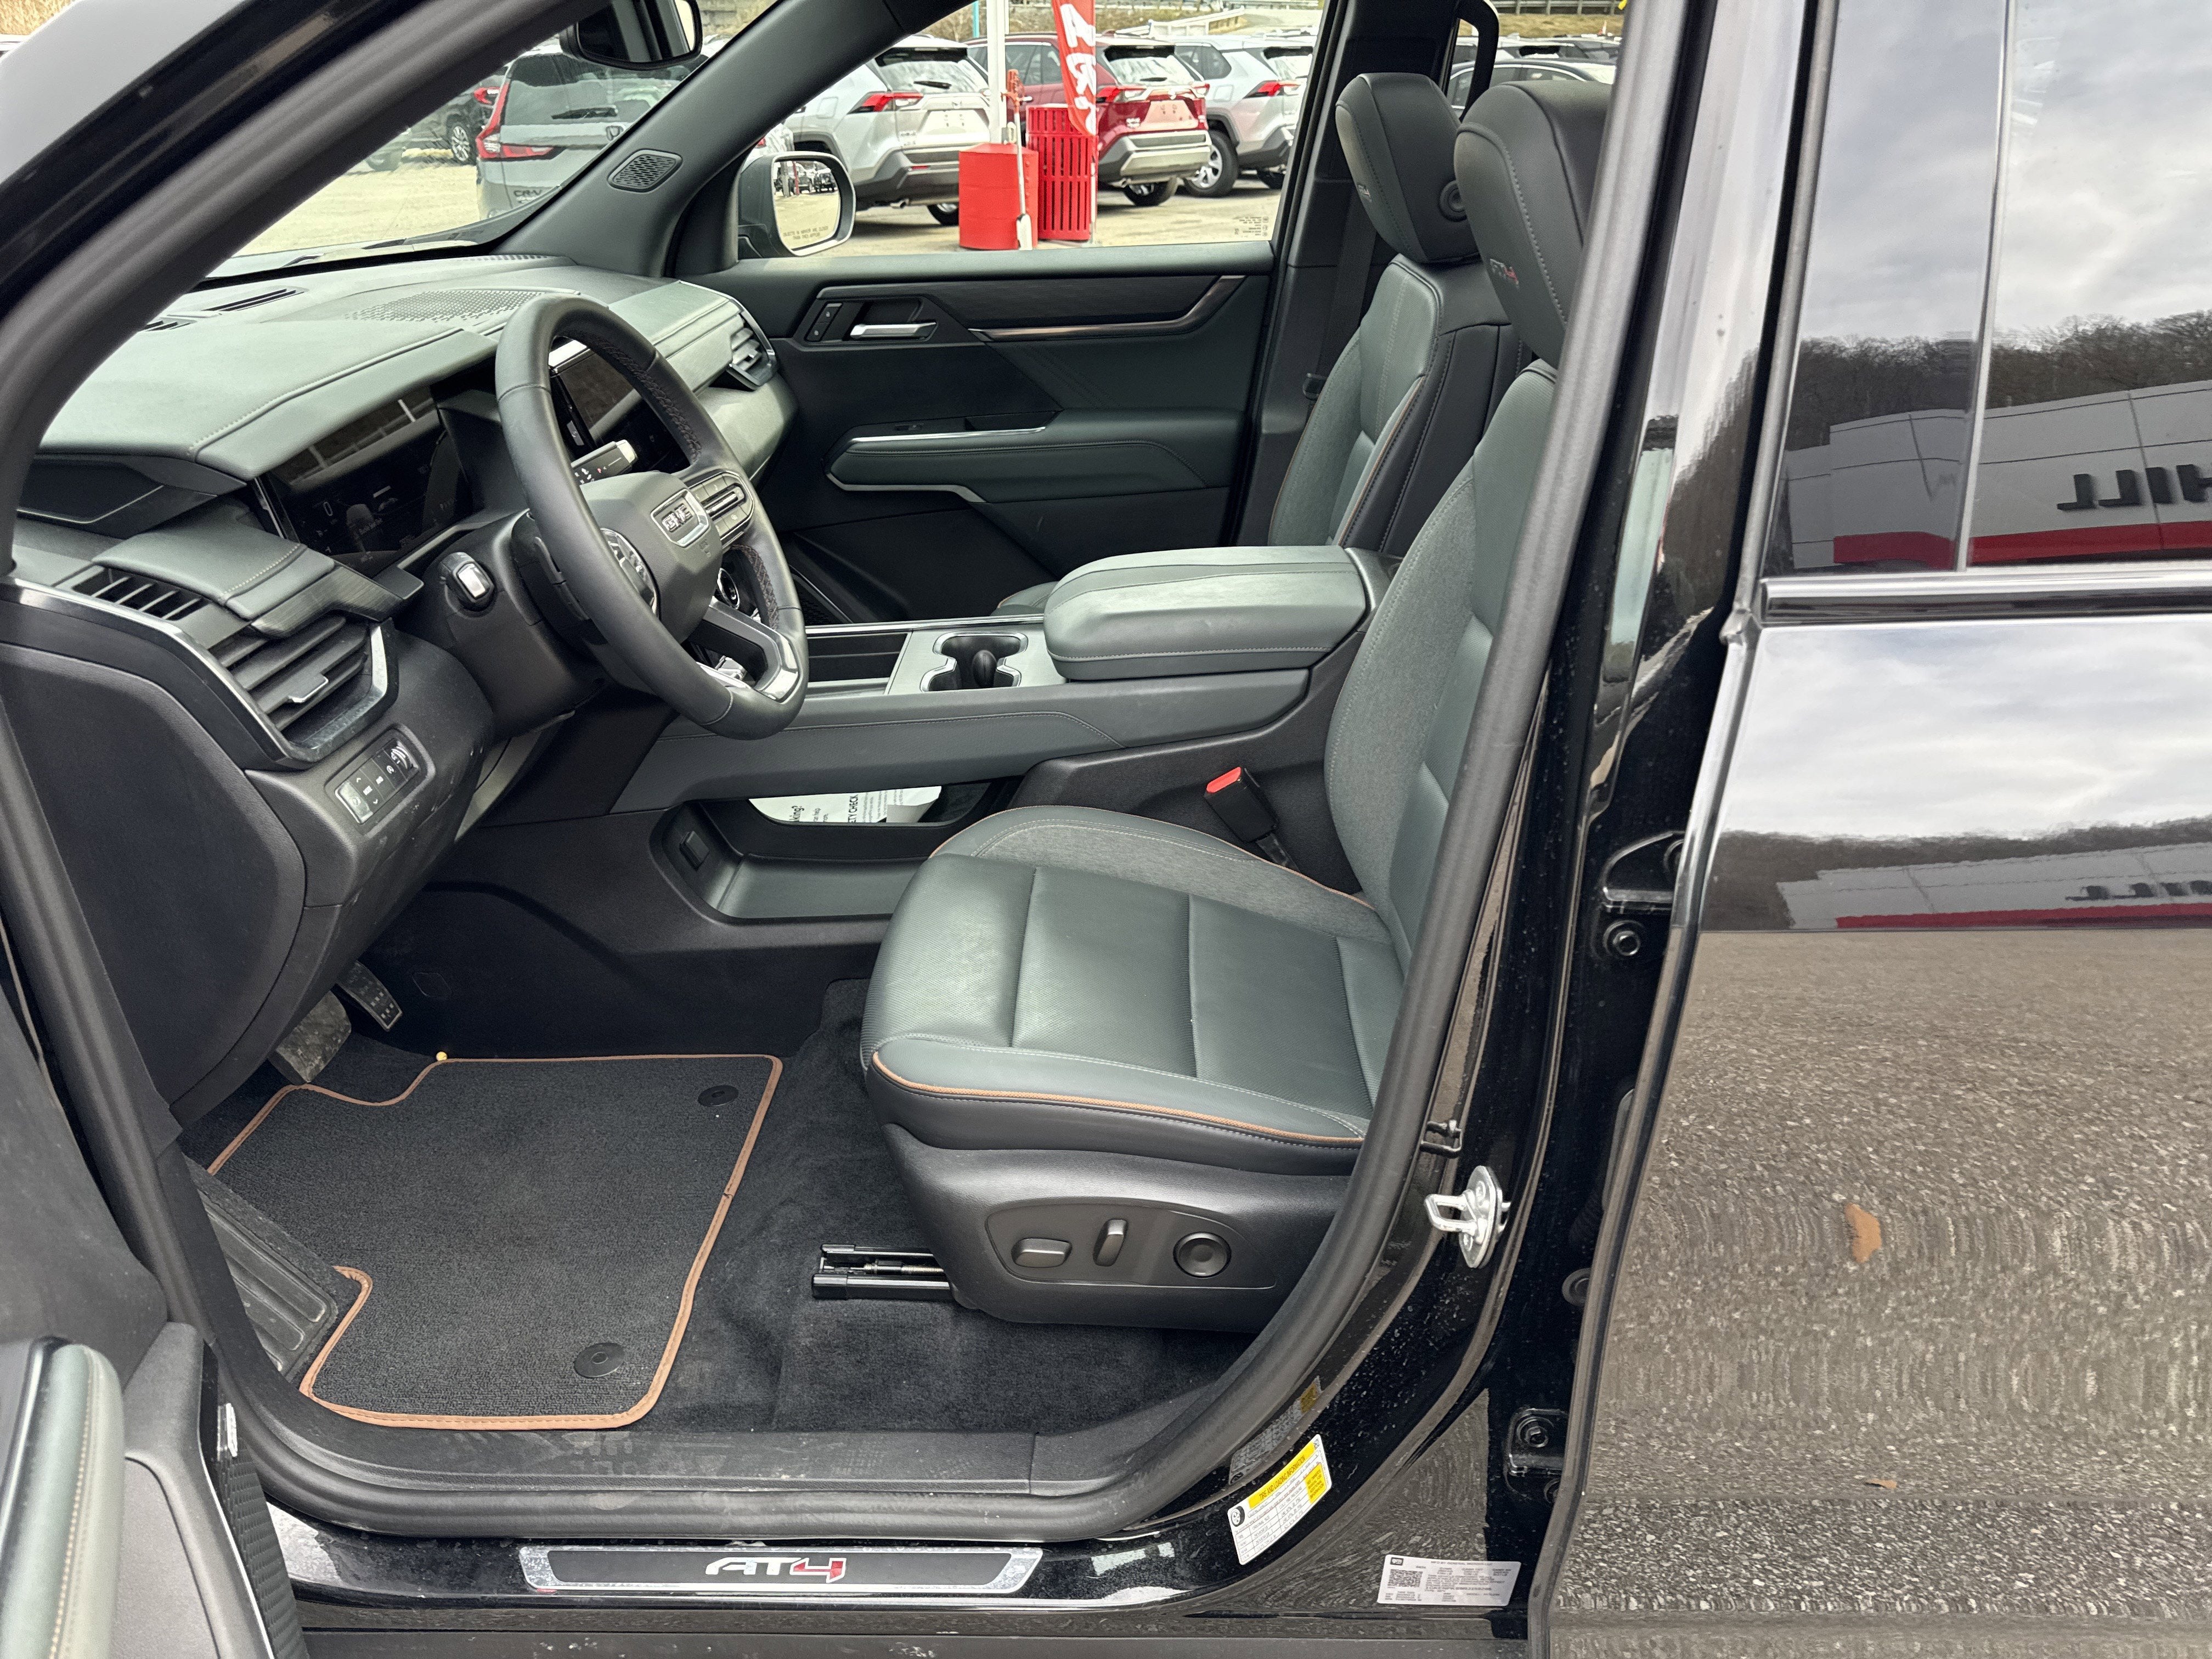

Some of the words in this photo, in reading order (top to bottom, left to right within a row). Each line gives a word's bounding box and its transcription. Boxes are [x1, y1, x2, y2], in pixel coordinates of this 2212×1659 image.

[662, 503, 693, 533] GMC
[848, 794, 859, 813] CHECK
[706, 1557, 847, 1583] AT4
